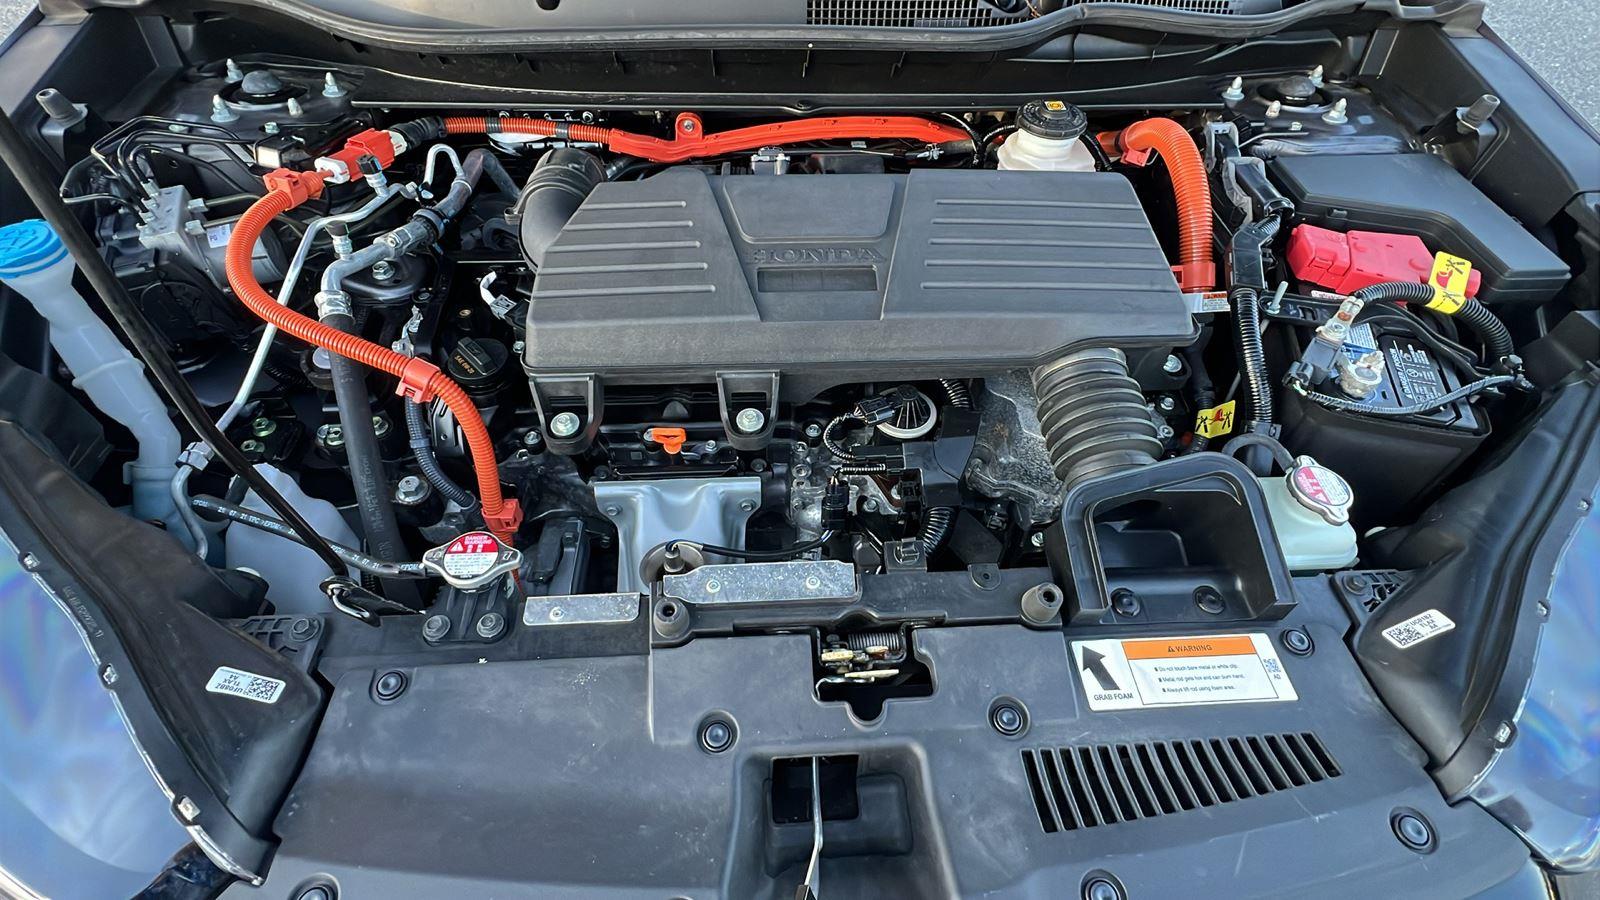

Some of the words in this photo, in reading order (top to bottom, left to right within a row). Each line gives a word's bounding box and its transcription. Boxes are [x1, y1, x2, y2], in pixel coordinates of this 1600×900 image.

[751, 248, 885, 263] HONDA
[1399, 371, 1411, 395] DANGER
[1114, 692, 1135, 700] FOAM
